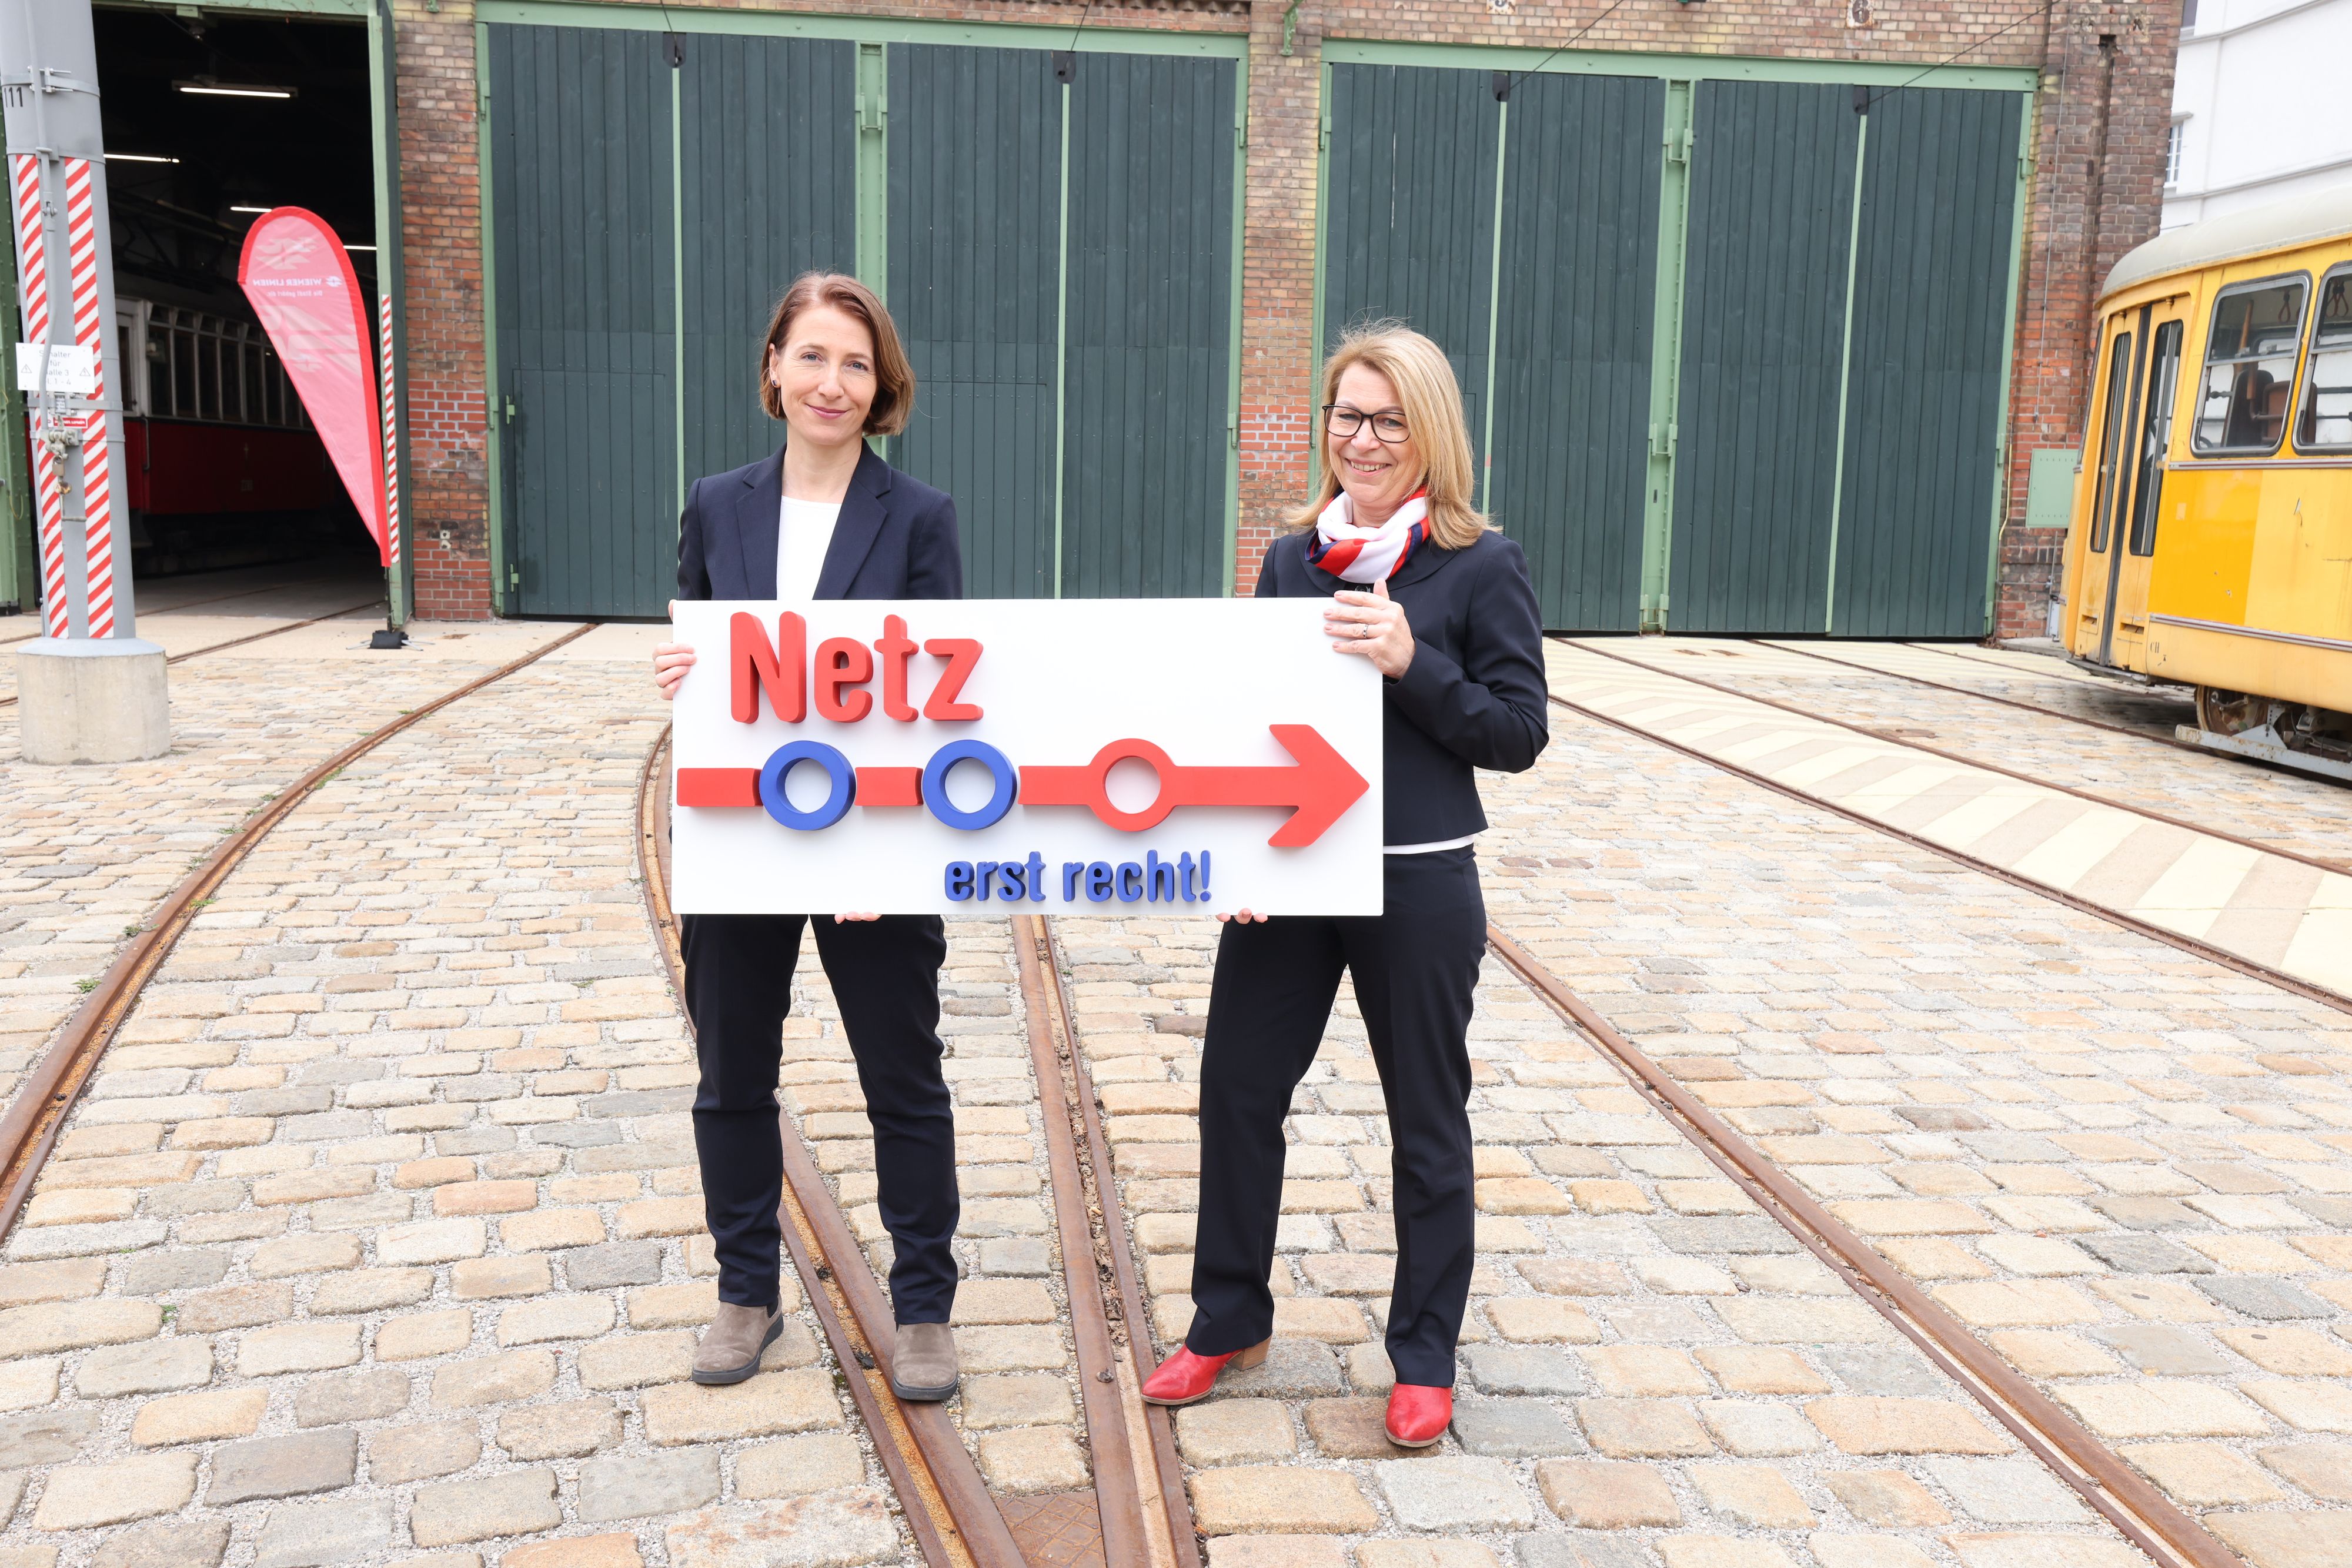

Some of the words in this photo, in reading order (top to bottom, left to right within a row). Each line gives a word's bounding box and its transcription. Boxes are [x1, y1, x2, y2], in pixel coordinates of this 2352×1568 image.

[65, 369, 69, 377] 3
[731, 611, 983, 724] Netz
[945, 852, 1045, 902] erst
[1063, 850, 1211, 902] recht!
